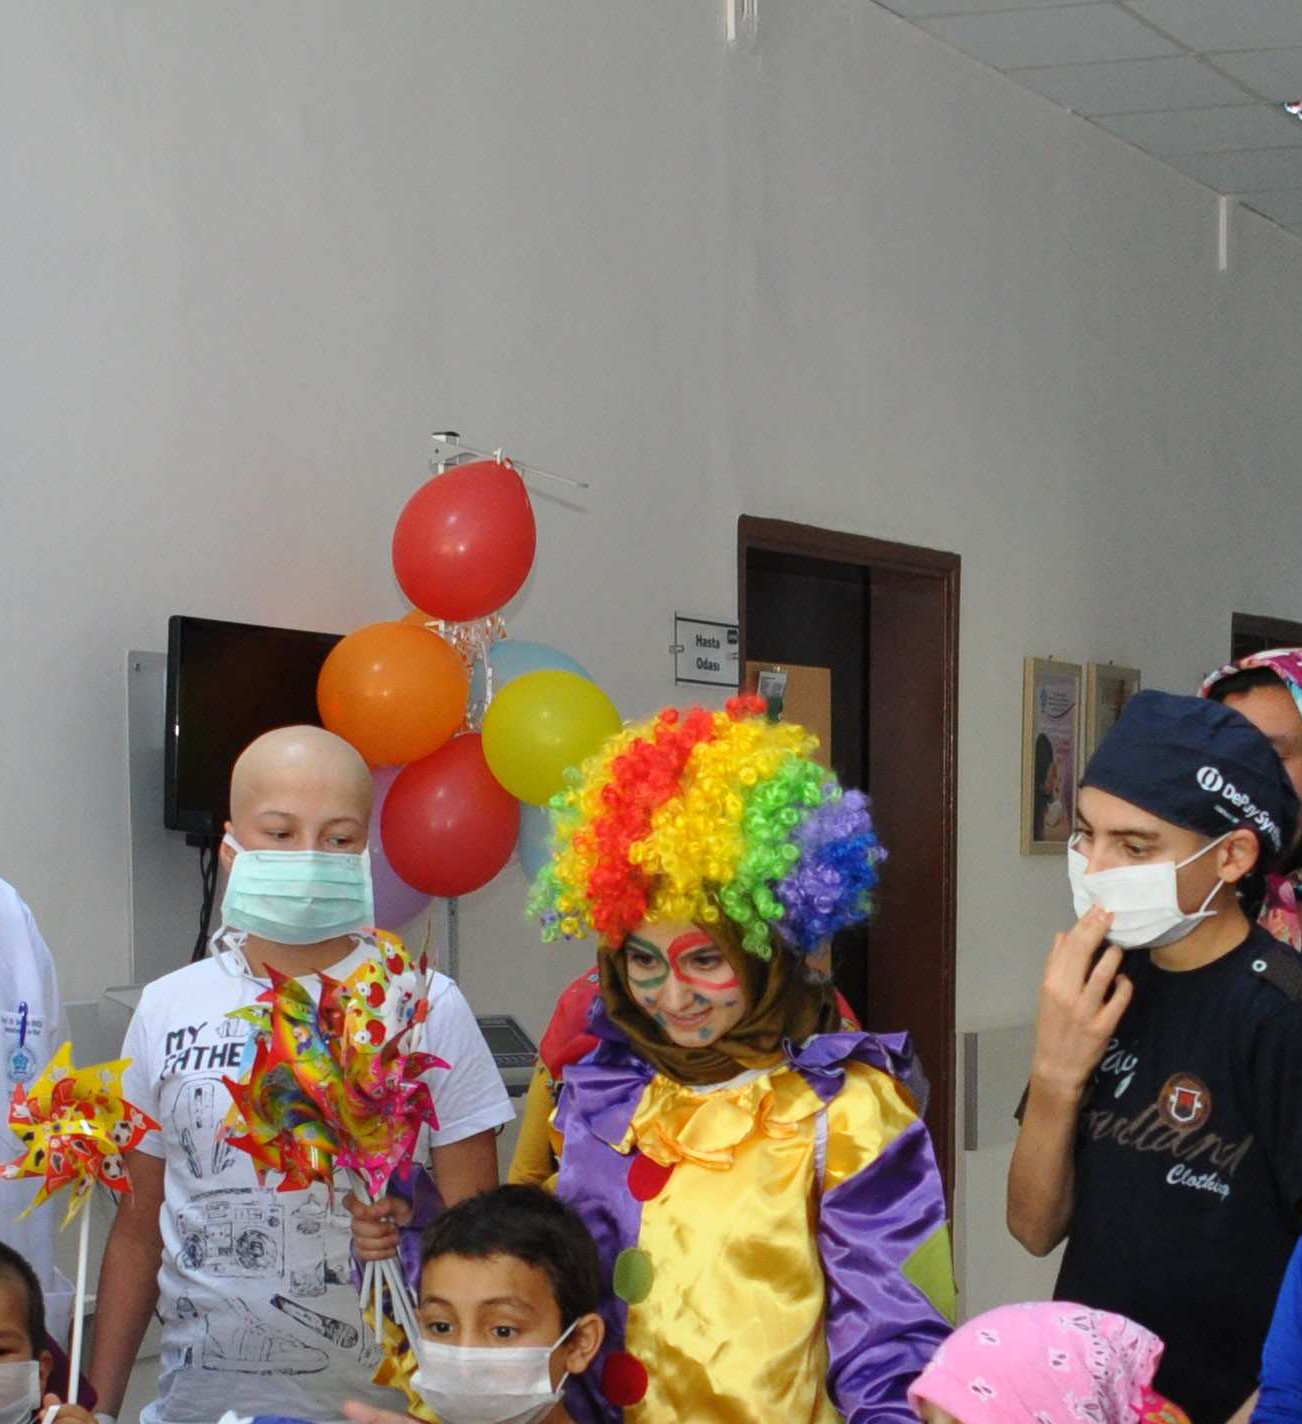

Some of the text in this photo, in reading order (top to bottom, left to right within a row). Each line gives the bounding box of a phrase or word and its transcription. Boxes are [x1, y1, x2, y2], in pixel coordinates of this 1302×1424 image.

[695, 634, 720, 649] Hasta
[696, 657, 720, 672] Odası
[165, 1021, 208, 1056] MY
